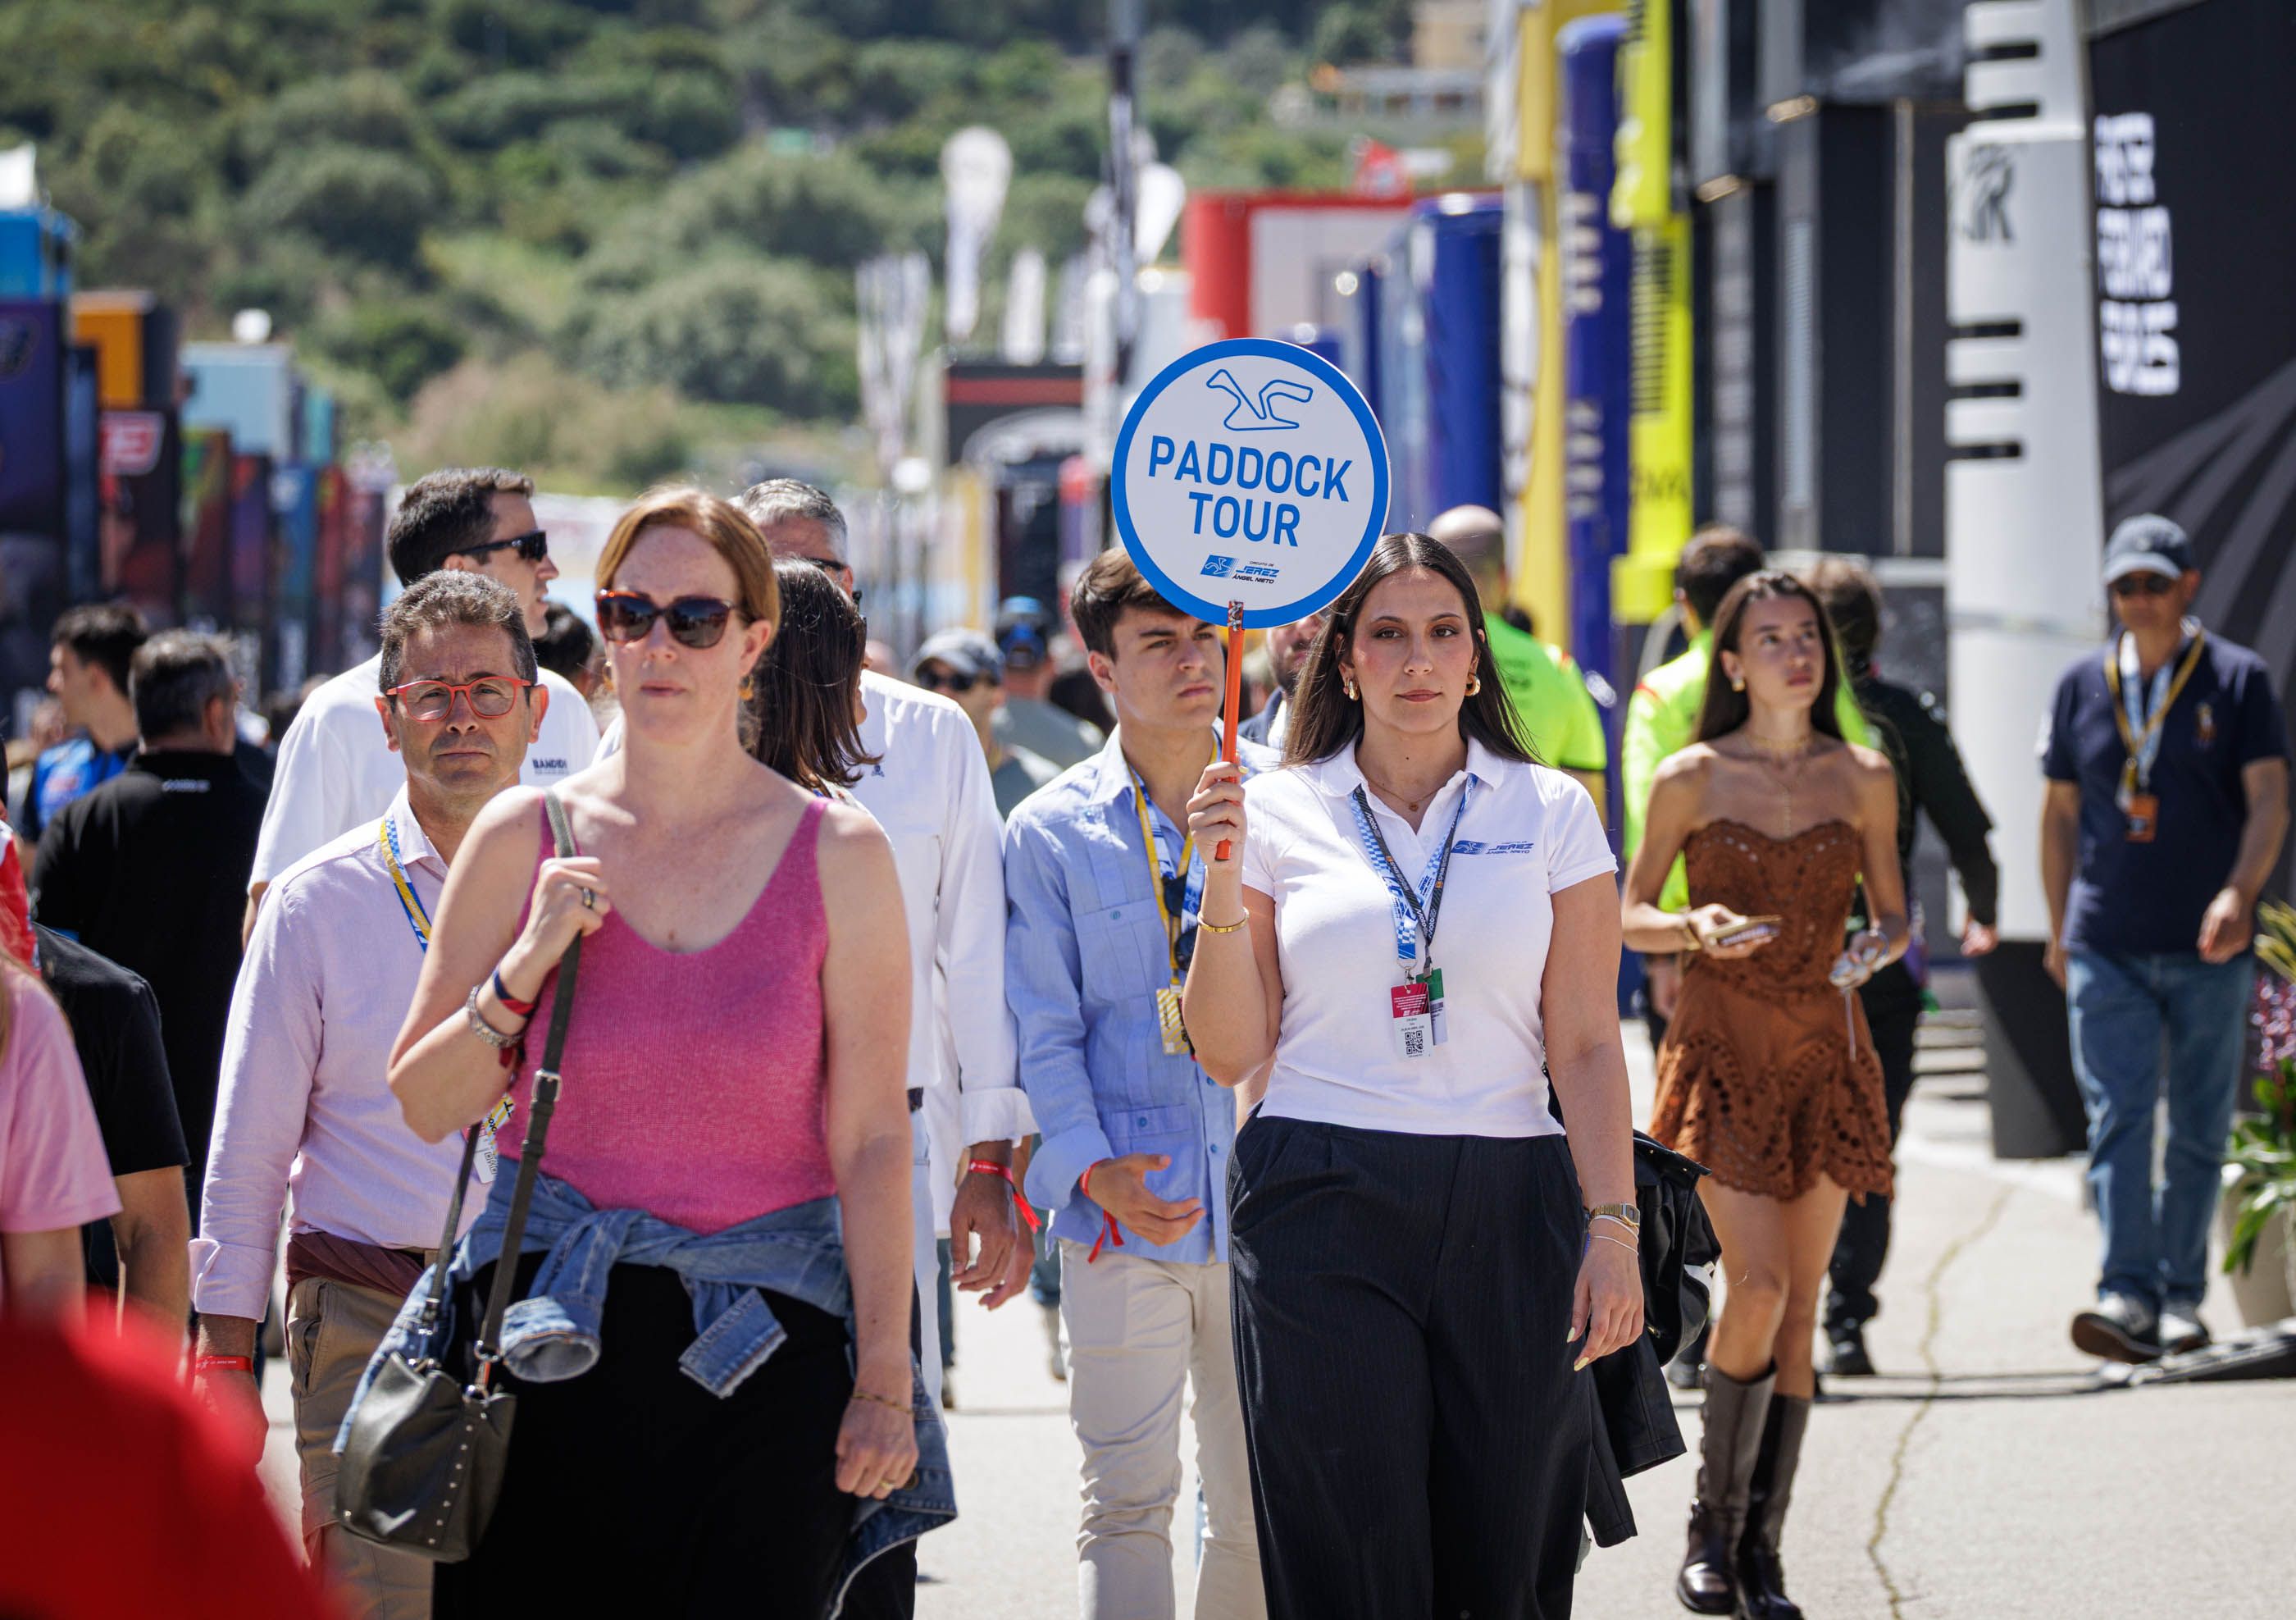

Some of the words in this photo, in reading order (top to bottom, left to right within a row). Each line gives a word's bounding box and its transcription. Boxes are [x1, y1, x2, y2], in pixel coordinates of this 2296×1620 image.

[1148, 436, 1353, 502] PADDOCK
[1189, 492, 1301, 547] TOUR
[1236, 565, 1279, 577] JEREZ
